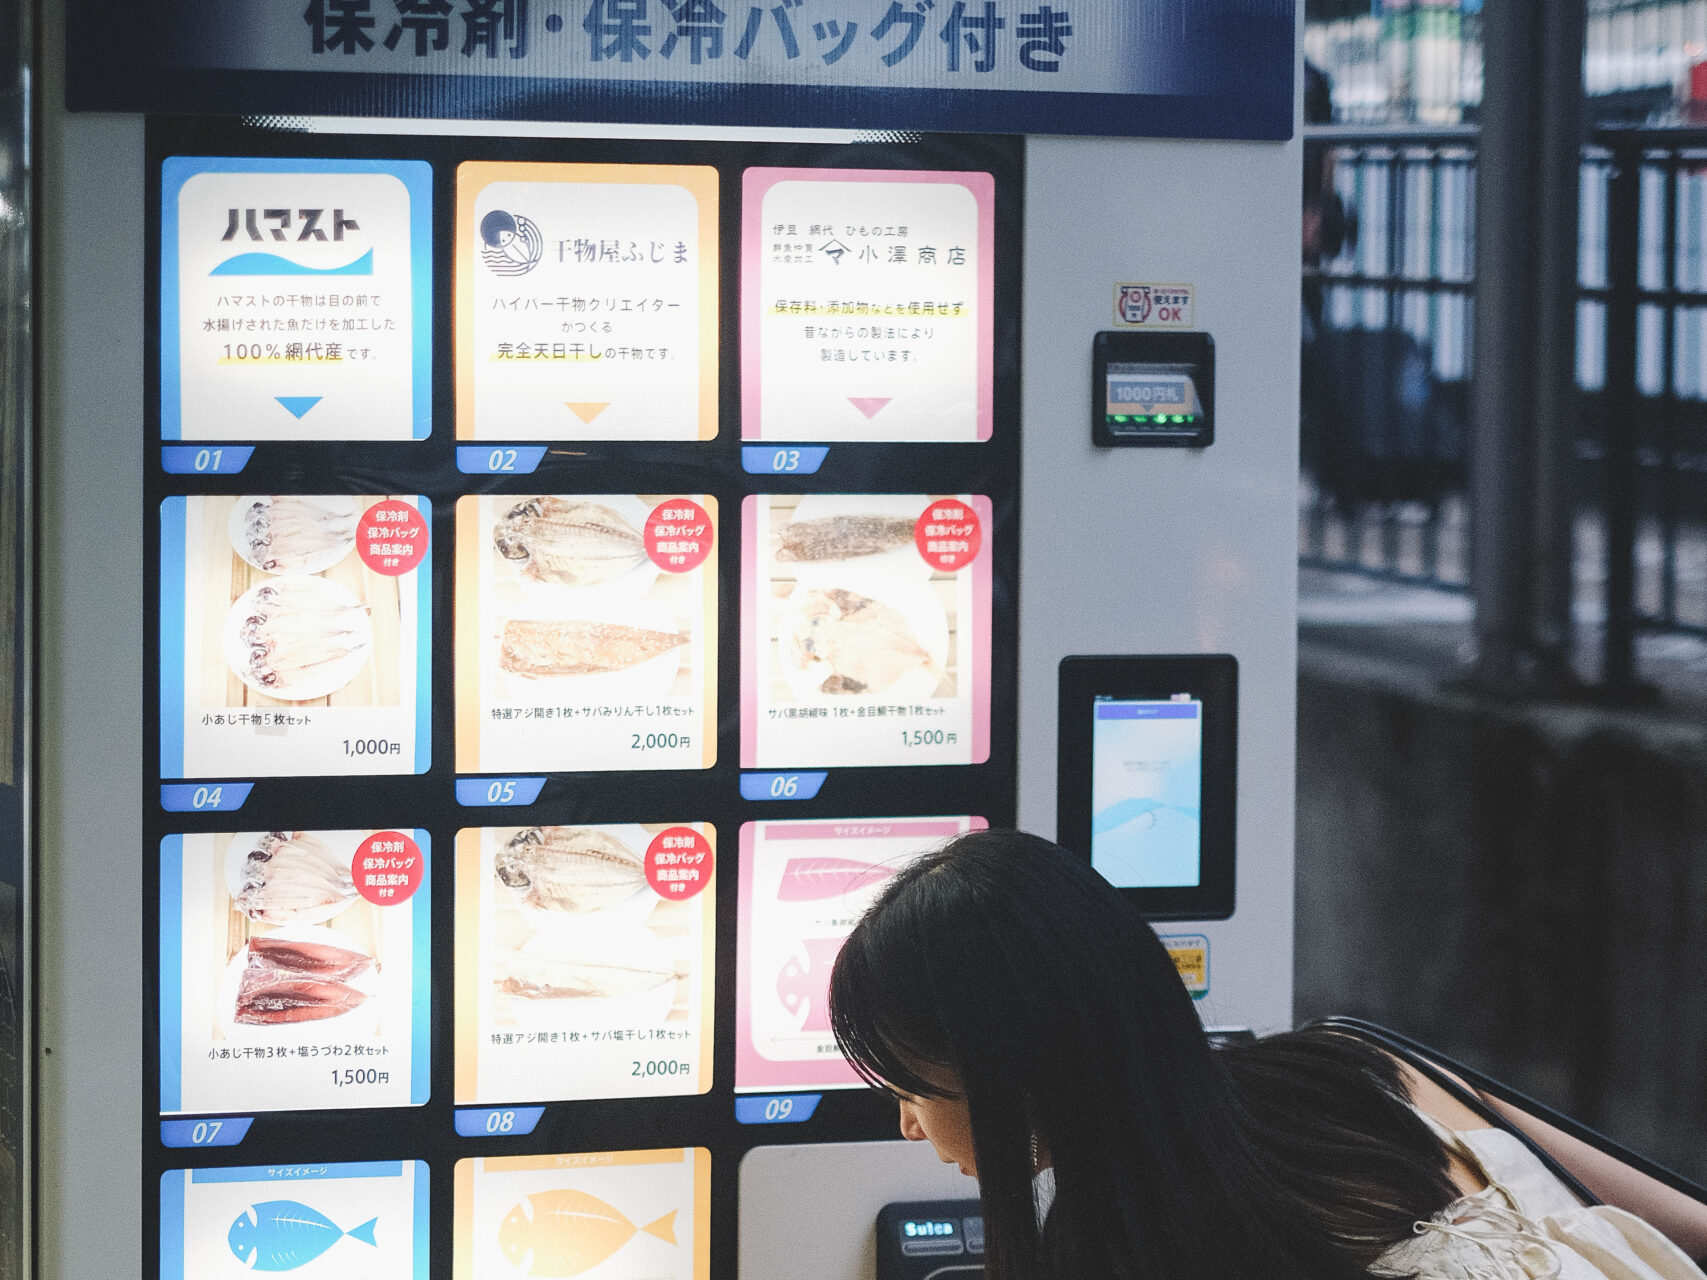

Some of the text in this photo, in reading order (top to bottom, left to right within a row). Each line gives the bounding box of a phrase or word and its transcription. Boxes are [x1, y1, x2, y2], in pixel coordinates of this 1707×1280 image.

[303, 0, 1073, 73] 保冷剤・保冷バッグ付き
[220, 208, 361, 242] ハマスト
[1158, 307, 1181, 321] OK
[194, 449, 223, 471] 01
[488, 449, 517, 471] 02
[772, 449, 800, 471] 03
[367, 526, 420, 539] 保冷バッグ
[201, 713, 312, 727] 小あじ干物5枚セット
[342, 739, 401, 757] 1,000円
[631, 733, 691, 751] 2,000円
[902, 729, 957, 747] 1,500円
[192, 786, 223, 808] 04
[487, 781, 517, 803] 05
[770, 776, 798, 797] 06
[363, 856, 416, 870] 保冷バッグ
[331, 1068, 389, 1087] 1,500円
[631, 1060, 690, 1078] 2,000円
[765, 1098, 793, 1120] 09
[486, 1111, 515, 1133] 08
[191, 1122, 223, 1144] 07
[268, 1166, 328, 1177] サイズイメージ
